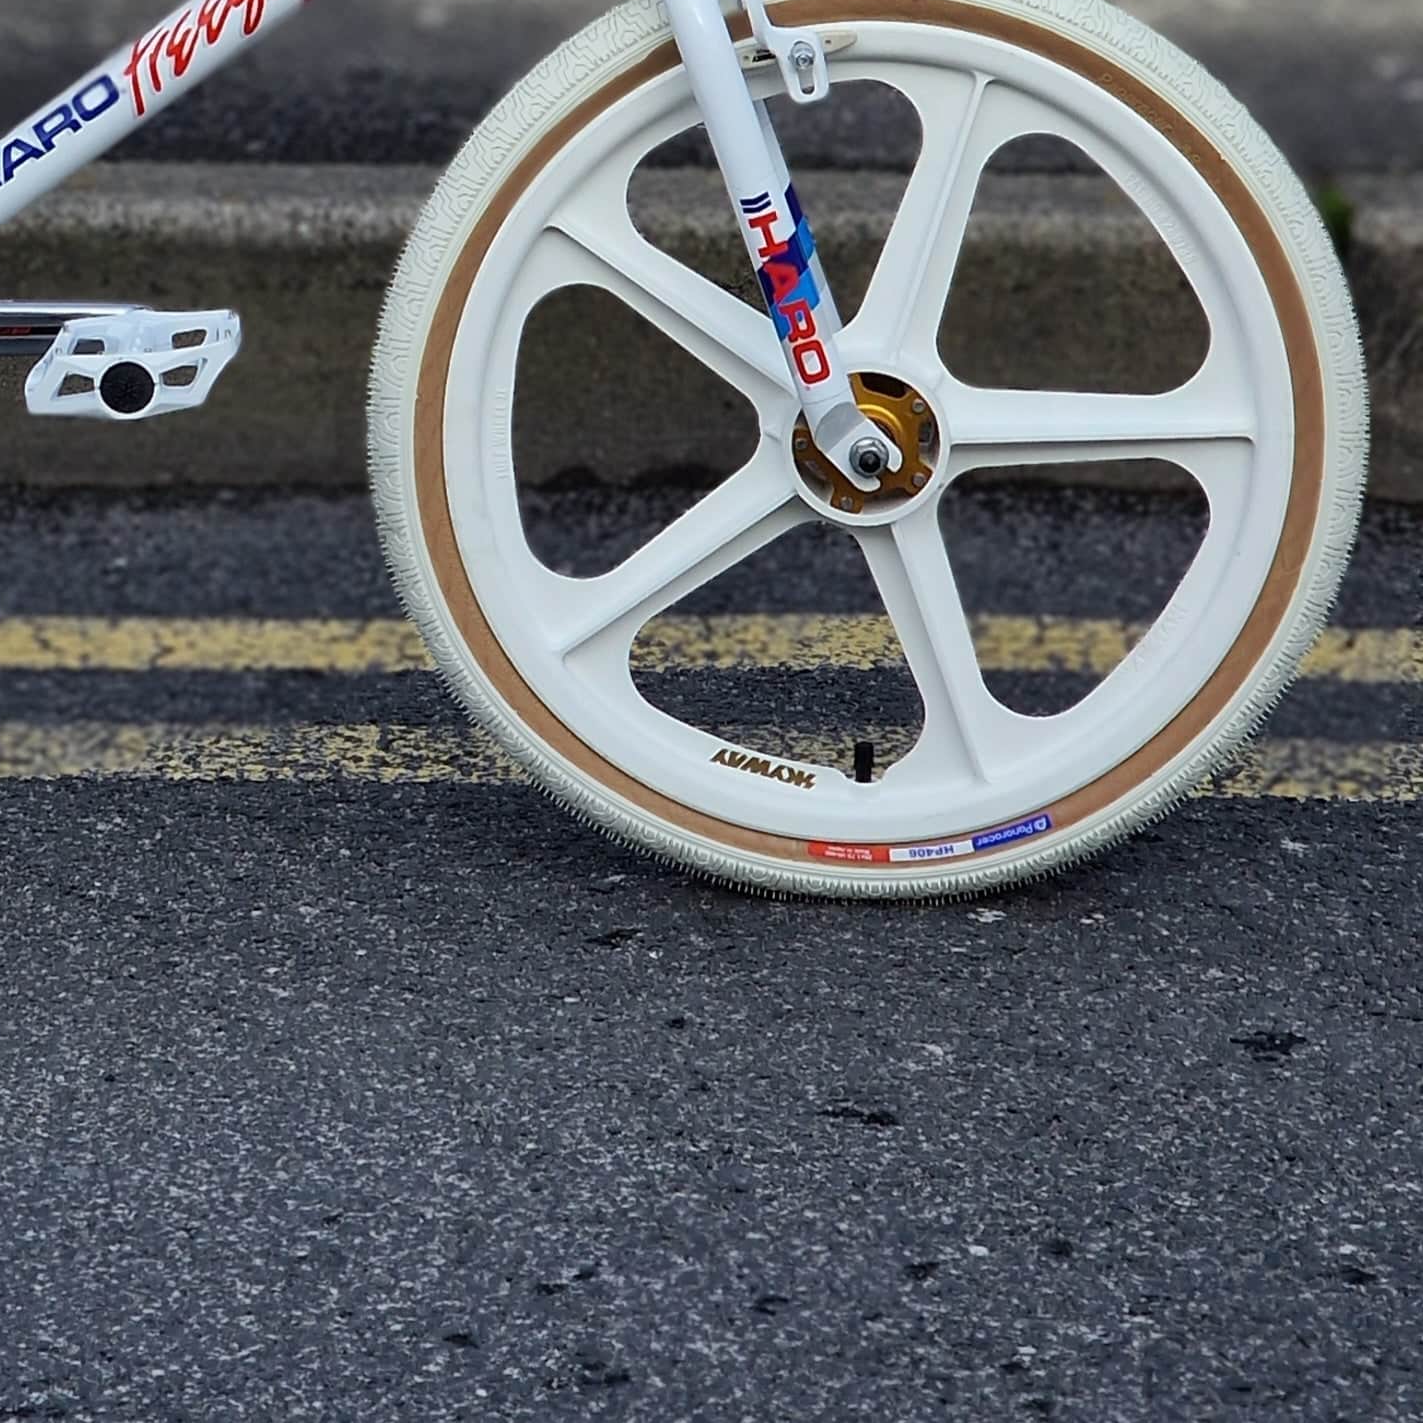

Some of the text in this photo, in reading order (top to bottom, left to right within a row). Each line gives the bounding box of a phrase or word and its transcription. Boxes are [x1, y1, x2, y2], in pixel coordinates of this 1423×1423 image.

[748, 211, 832, 386] HARO
[710, 748, 817, 790] SKYWAY
[908, 822, 1035, 859] Panaracer HP406
